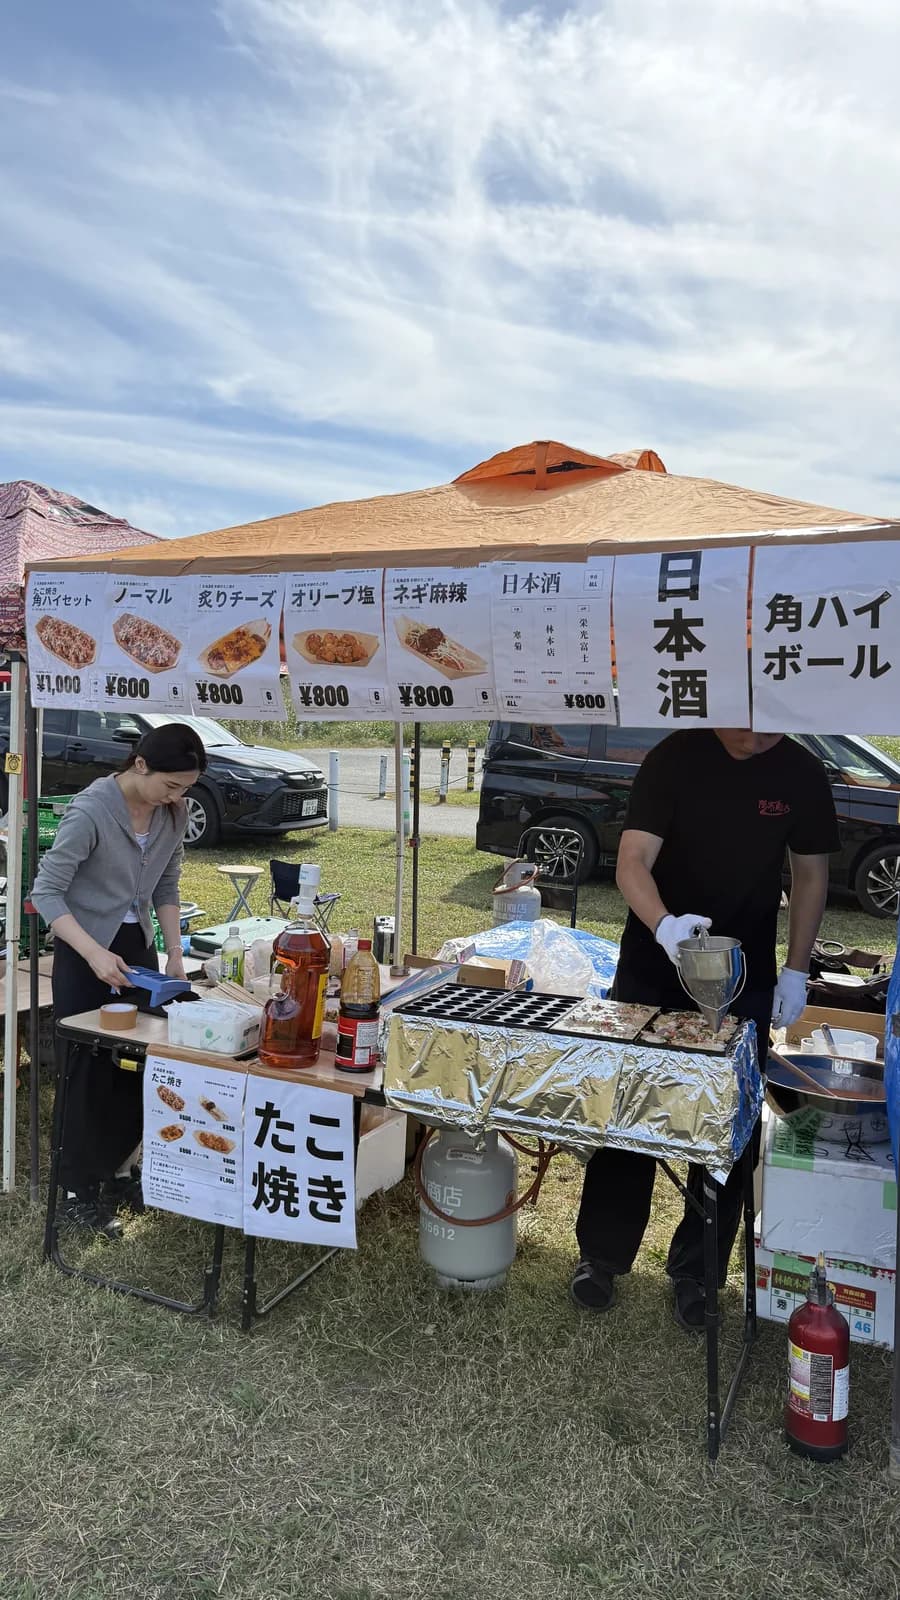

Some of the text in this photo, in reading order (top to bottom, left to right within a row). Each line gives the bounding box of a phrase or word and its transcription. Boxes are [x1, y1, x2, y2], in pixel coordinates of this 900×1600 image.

[33, 587, 57, 595] たこ焼き
[393, 581, 468, 604] ネギ麻辣
[502, 572, 561, 595] 日本酒
[32, 594, 92, 607] 角ハイセット
[114, 588, 173, 604] ノーマル
[198, 589, 278, 608] 炙りチーズ
[291, 585, 375, 607] オリーブ塩
[764, 590, 892, 634] 角ハイ
[653, 551, 709, 719] 日本酒
[762, 642, 892, 681] ボール
[36, 674, 81, 695] ¥1,000
[105, 676, 150, 699] ¥600
[172, 686, 179, 696] 6
[195, 682, 244, 705] ¥800
[299, 684, 350, 707] ¥800
[481, 690, 489, 700] 6
[266, 691, 273, 701] 6
[373, 691, 380, 701] 6
[398, 685, 454, 707] ¥800
[564, 693, 606, 709] ¥800
[151, 1073, 182, 1088] たこ焼き
[254, 1101, 344, 1161] たこ
[251, 1161, 347, 1223] 焼き
[424, 1178, 463, 1207] 商店
[854, 1320, 872, 1334] 46
